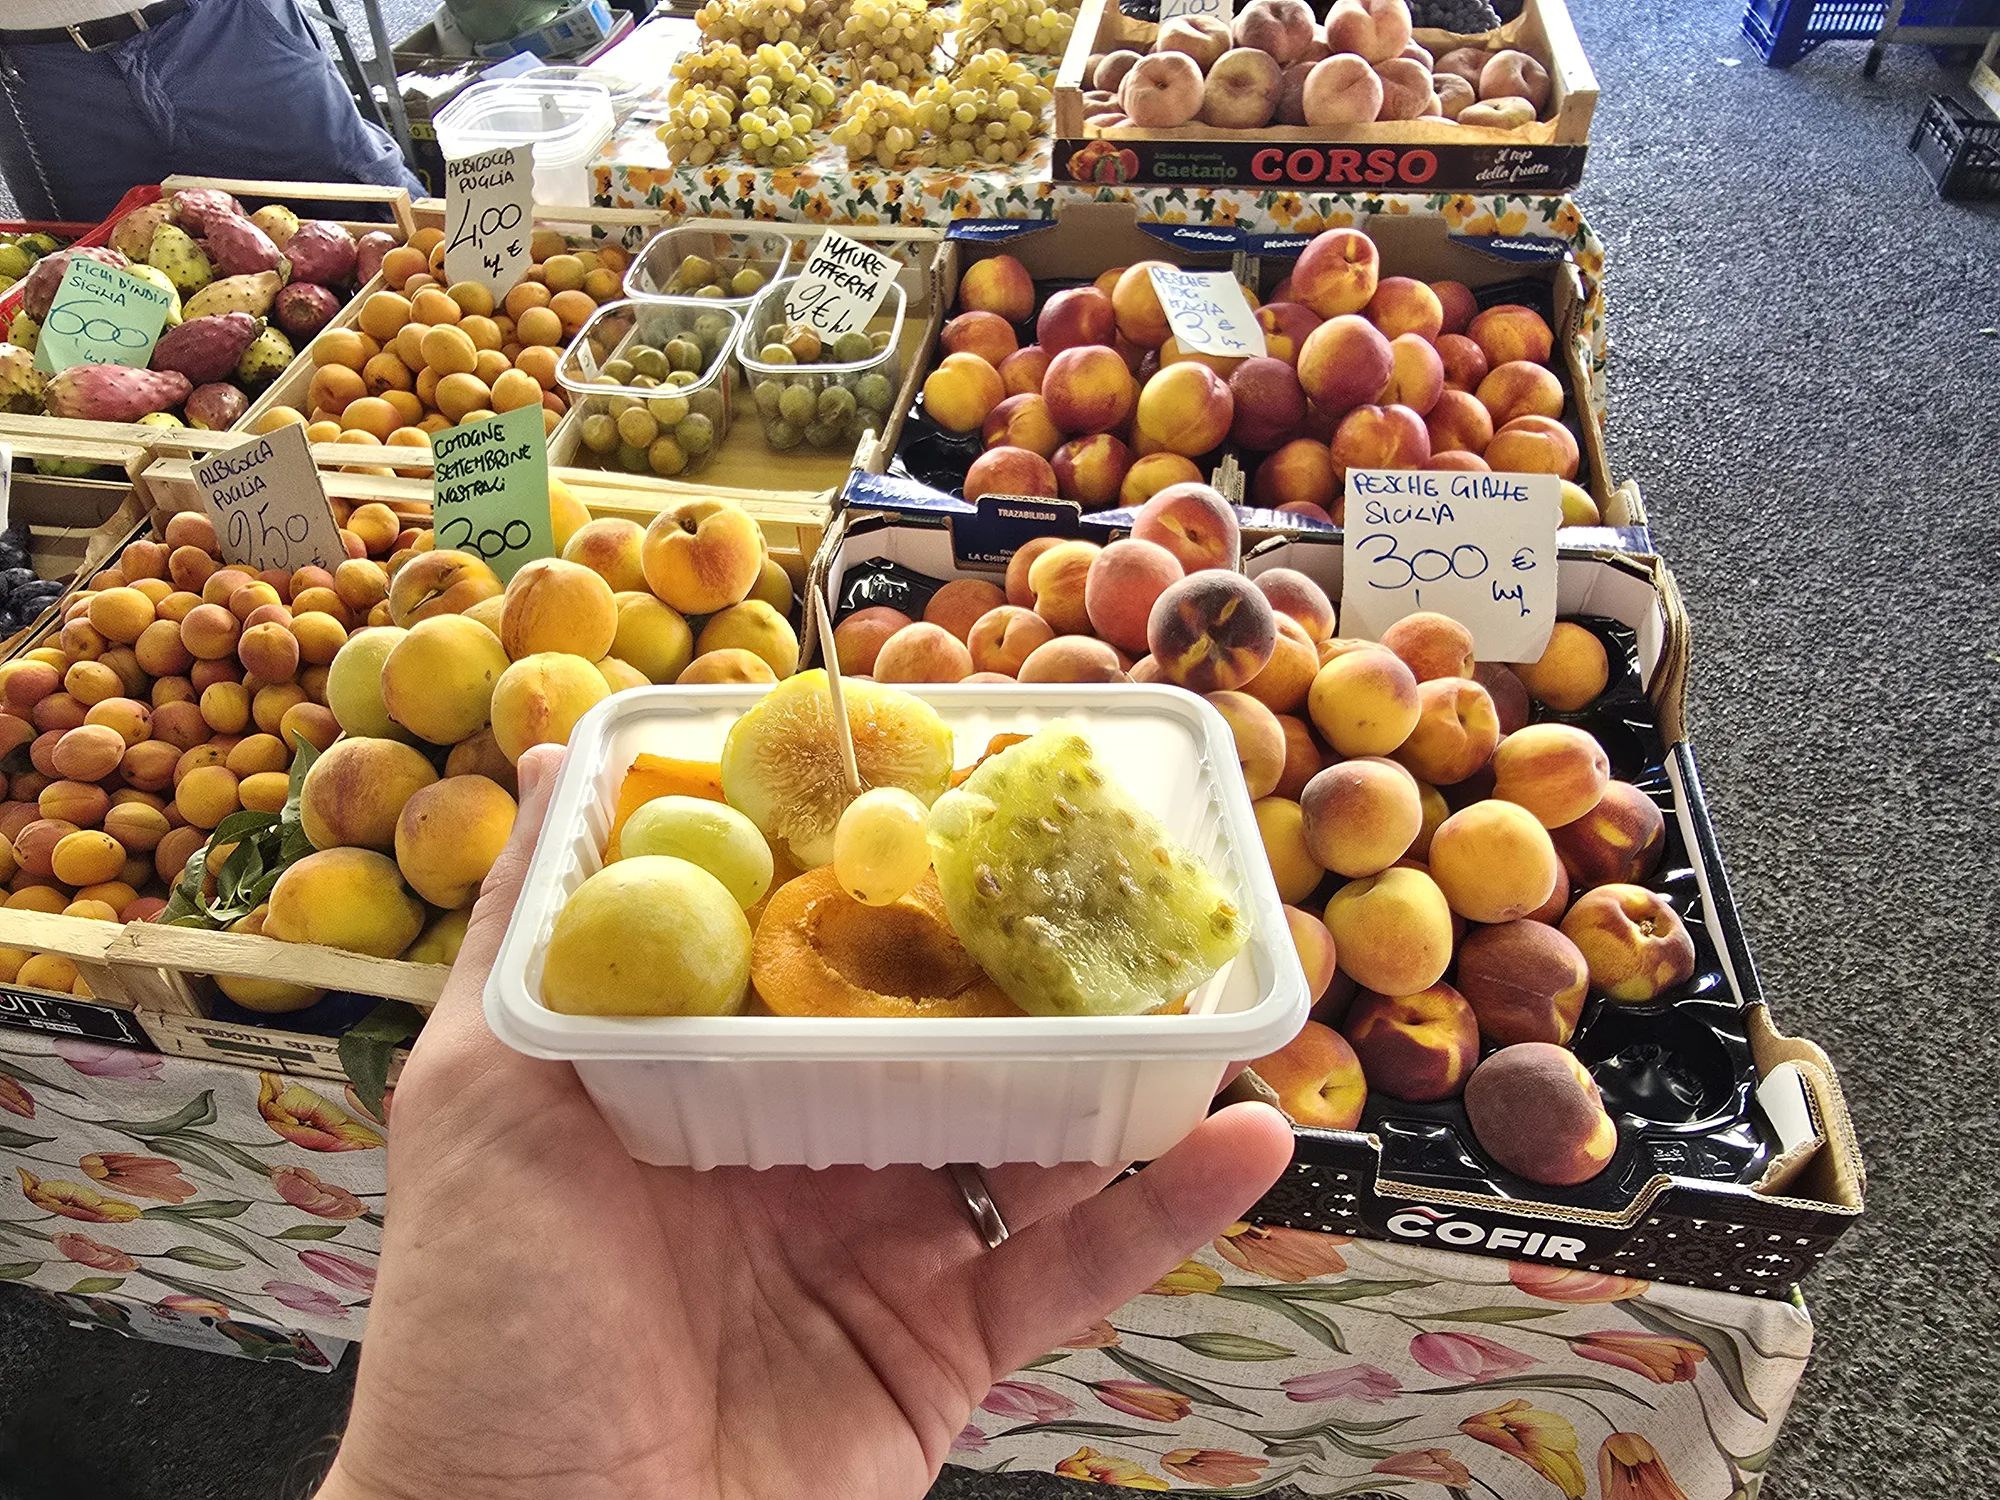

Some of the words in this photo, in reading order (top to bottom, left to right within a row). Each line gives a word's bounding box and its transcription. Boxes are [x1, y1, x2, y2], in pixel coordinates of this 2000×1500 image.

[448, 150, 515, 178] ALBICOCCA
[1152, 161, 1238, 178] Gaetano
[1251, 148, 1438, 183] CORSO
[459, 170, 514, 194] PUGLIA
[823, 236, 888, 278] MATURE
[808, 257, 879, 302] OFFERTA
[1174, 310, 1212, 344] 3
[434, 422, 506, 460] COTOGNE
[200, 439, 274, 488] ALBICOCCA
[436, 444, 532, 483] SETTEMBRINE
[212, 474, 267, 511] PUGLIA
[437, 476, 506, 508] NOSTRALI
[1353, 472, 1439, 497] PESCHE
[1450, 475, 1529, 501] GIALLE
[997, 508, 1057, 521] TRAZABILIDAD
[1365, 500, 1455, 525] SICILIA
[968, 553, 981, 561] LA
[1511, 547, 1537, 571] €
[1386, 1212, 1587, 1262] COFIR
